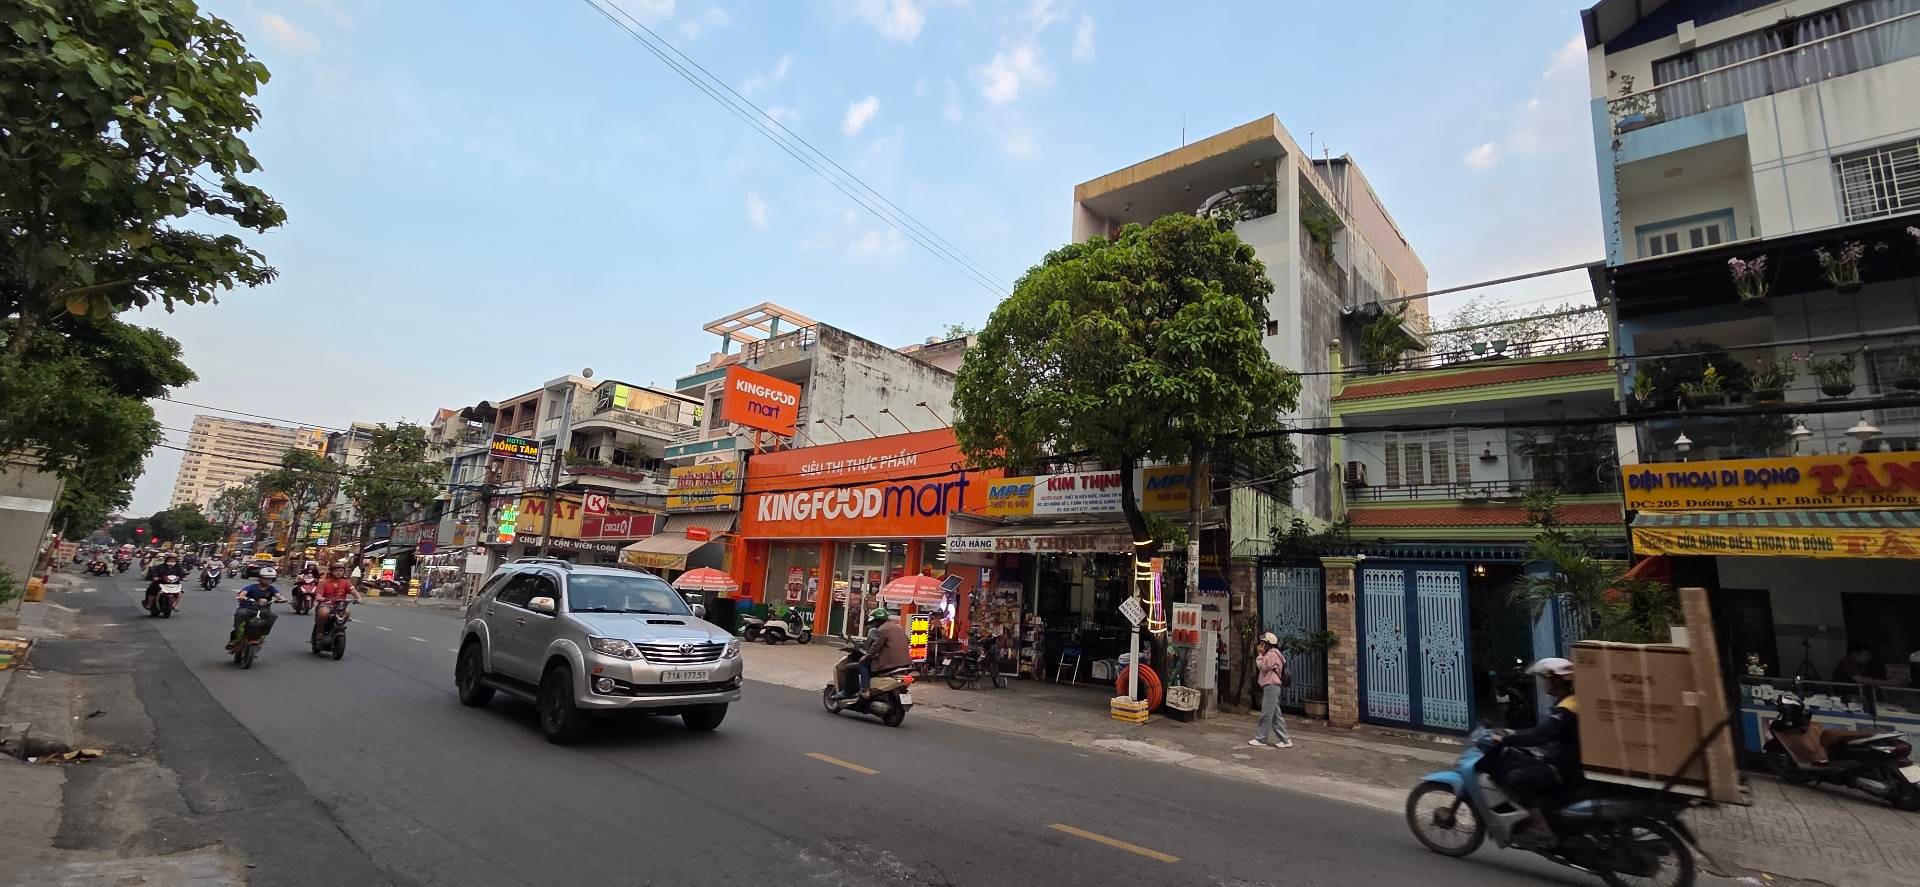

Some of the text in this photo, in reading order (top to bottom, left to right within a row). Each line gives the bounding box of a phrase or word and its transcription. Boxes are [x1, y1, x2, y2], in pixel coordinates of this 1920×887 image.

[736, 378, 796, 407] KINGFOOD
[748, 400, 781, 419] mart
[506, 437, 527, 446] HOTEL
[520, 445, 538, 456] TÂM
[800, 461, 824, 477] SIÊU
[826, 461, 844, 475] THỊ
[846, 456, 878, 472] THỰC
[1048, 477, 1075, 491] KIM
[1629, 470, 1663, 492] ĐIỆN
[1667, 470, 1718, 491] THOẠI
[1722, 469, 1739, 487] DI
[989, 484, 1031, 498] MPE
[950, 538, 967, 548] CỬA
[968, 539, 992, 548] HÀNG
[1677, 531, 1697, 549] CỬA
[1699, 533, 1726, 549] HÀNG
